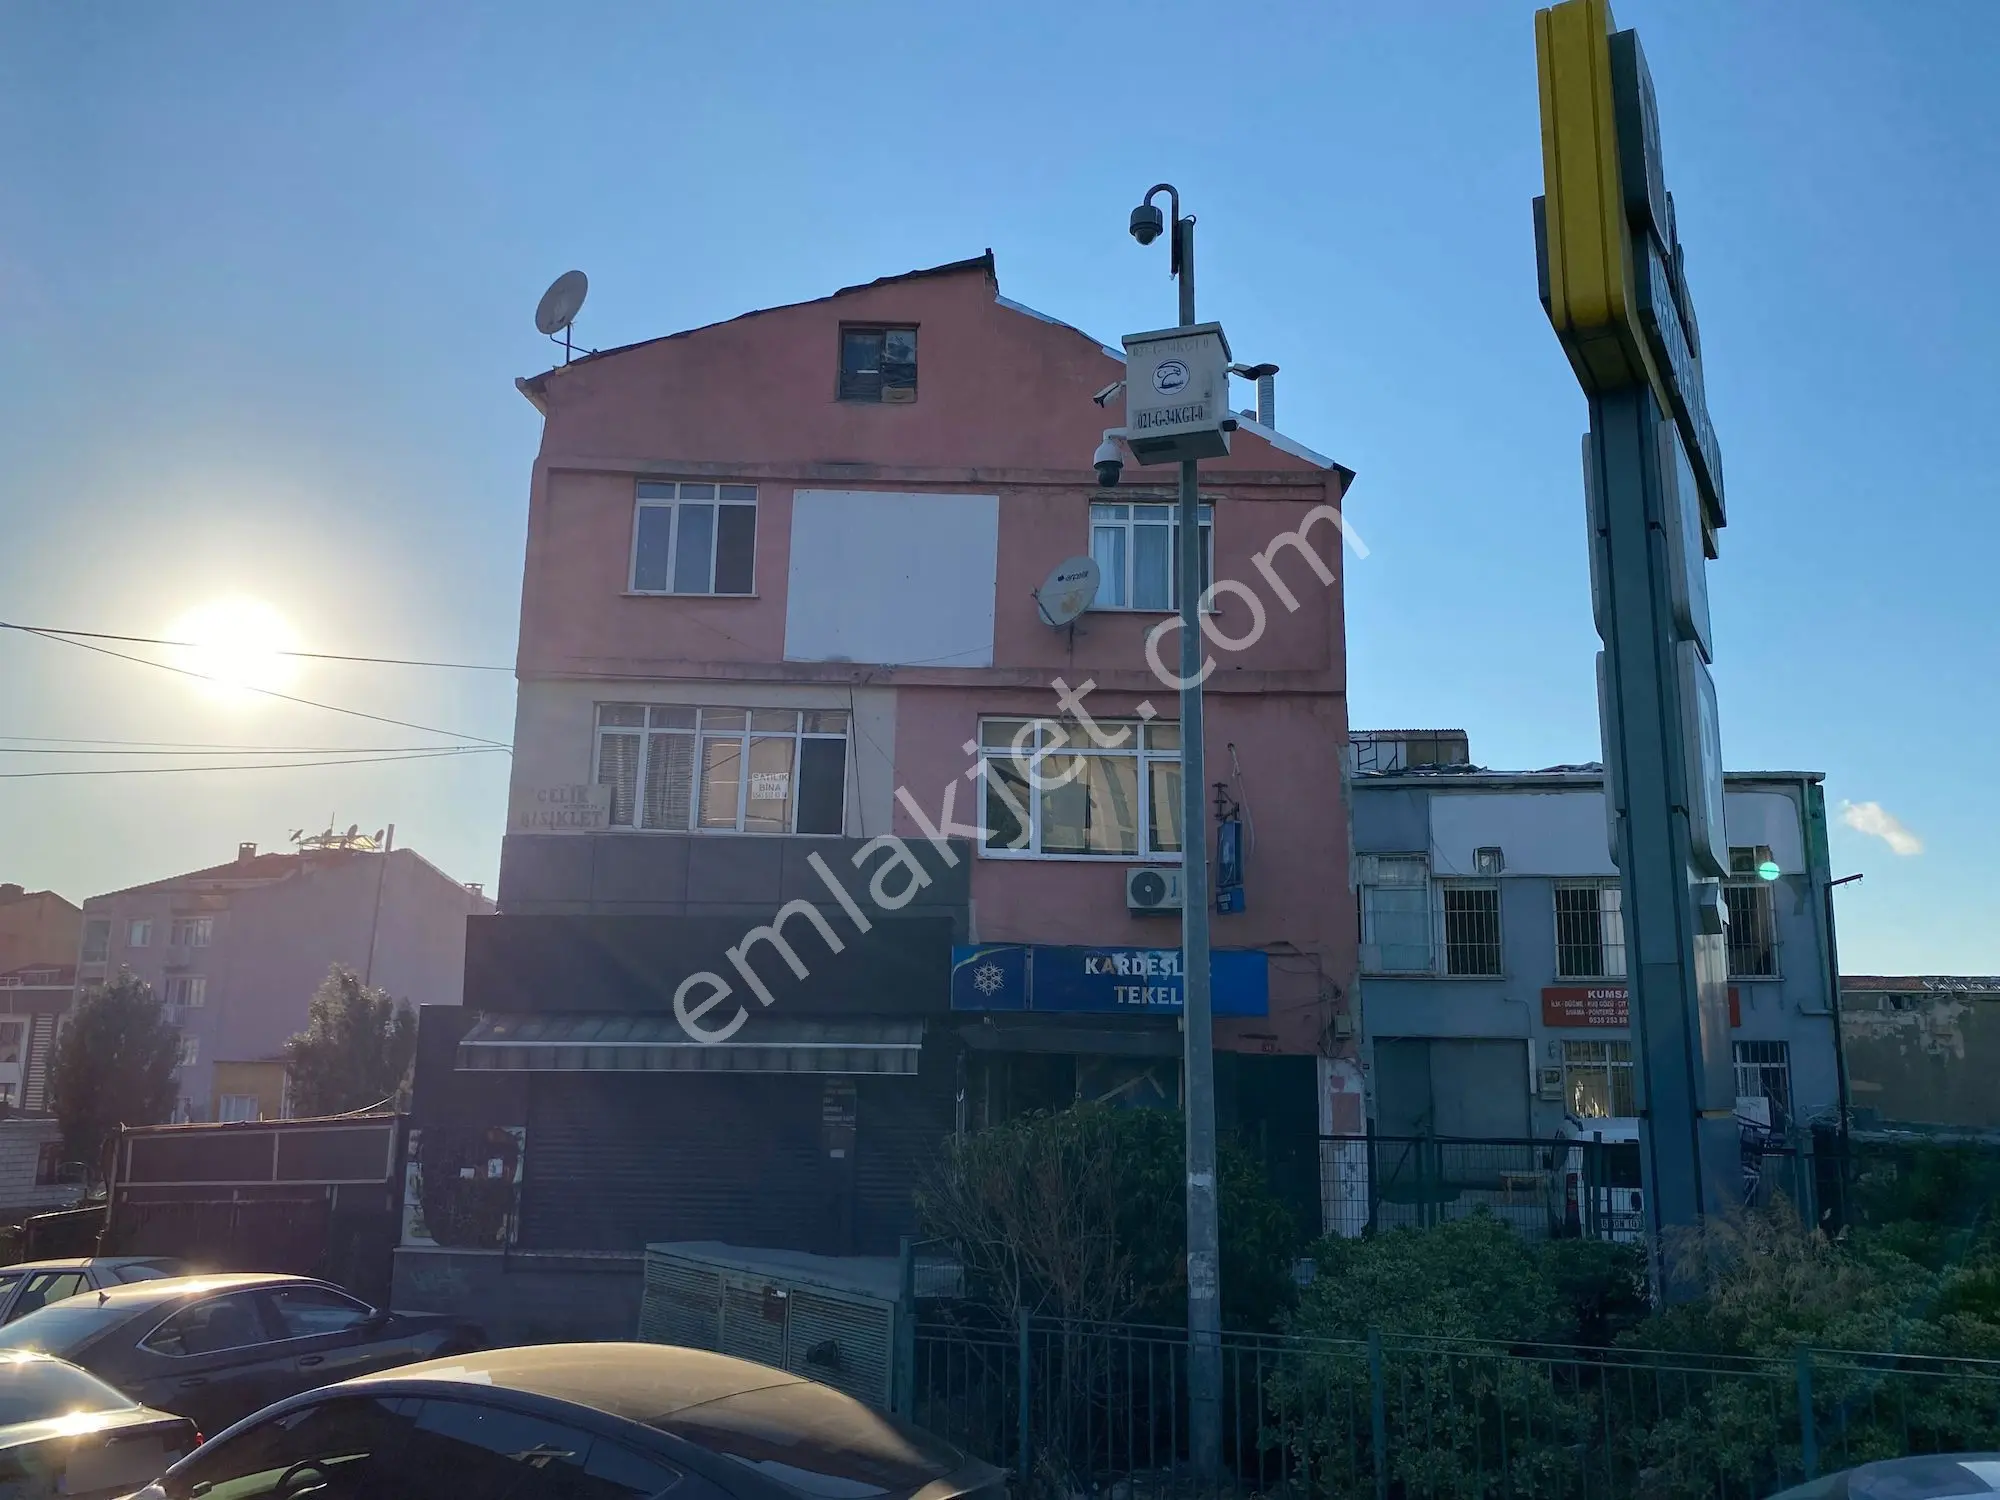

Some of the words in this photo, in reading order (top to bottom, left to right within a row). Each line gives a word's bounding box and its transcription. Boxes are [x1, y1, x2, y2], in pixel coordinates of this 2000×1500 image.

[1085, 957, 1211, 980] KARDEŞL
[1114, 985, 1183, 1005] TEKEL
[1587, 990, 1629, 999] KUMSA
